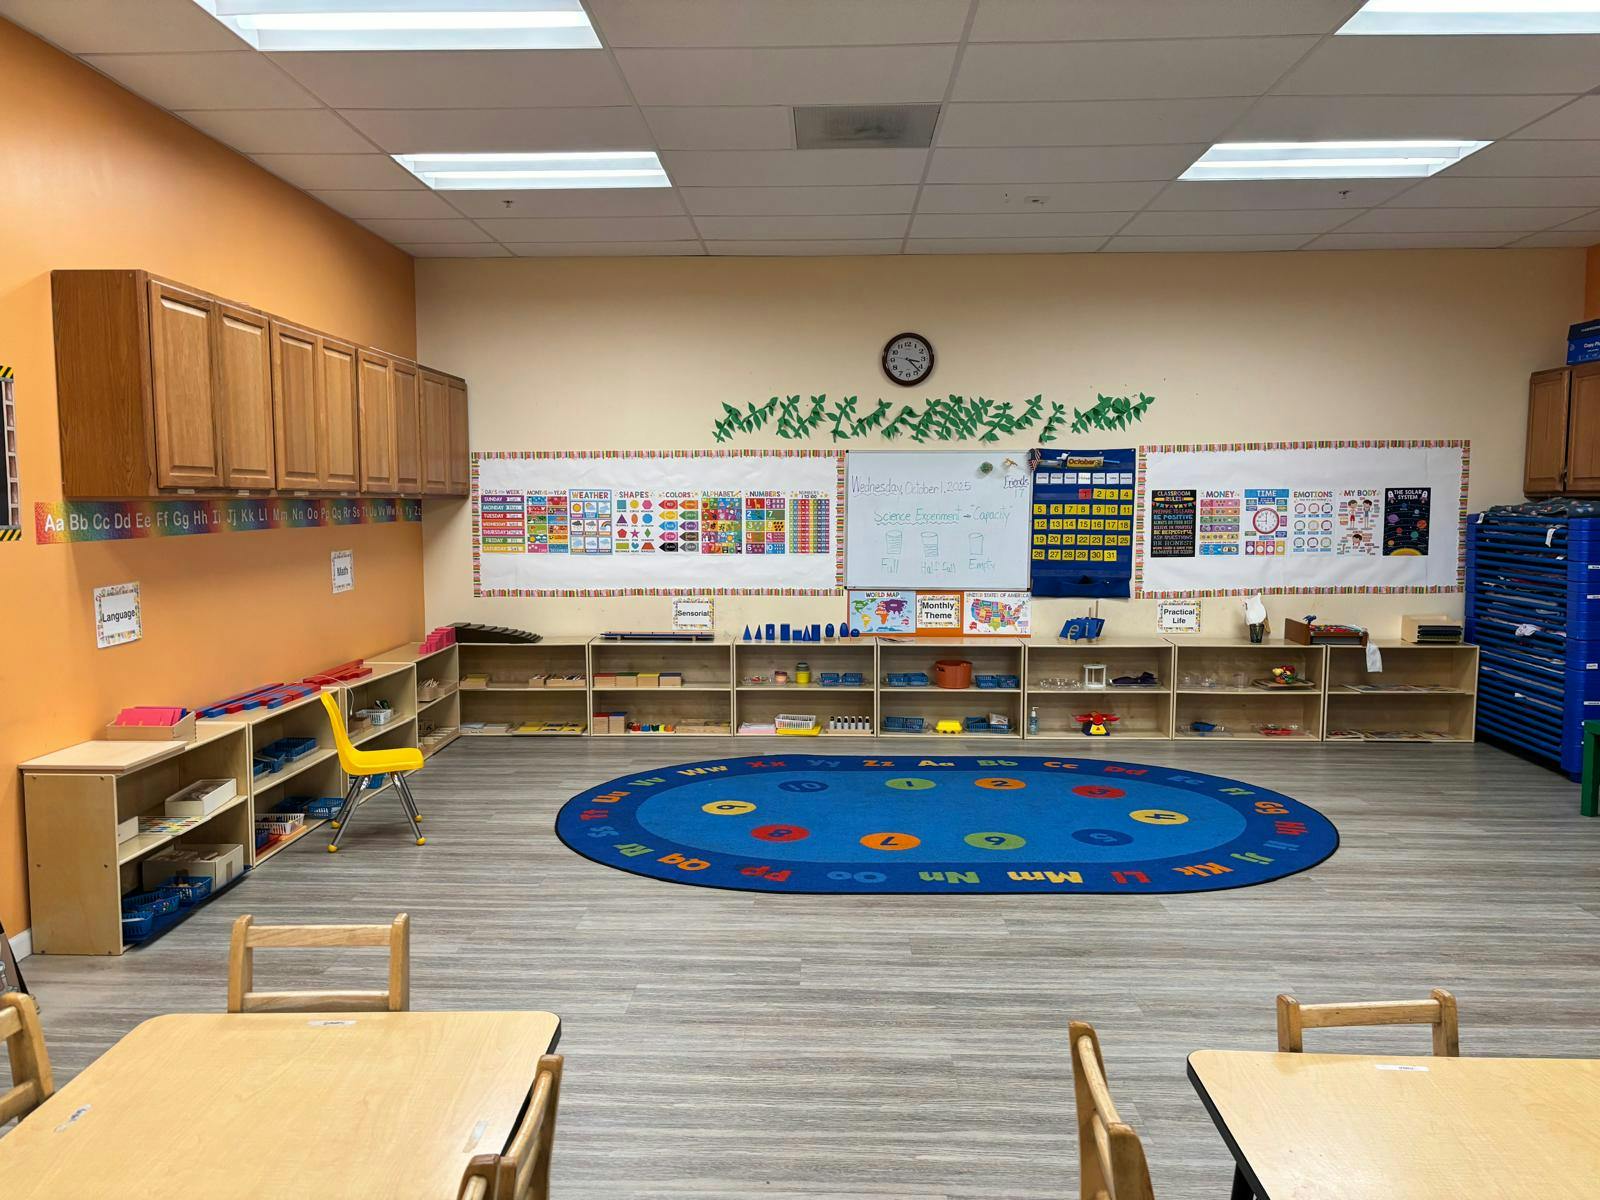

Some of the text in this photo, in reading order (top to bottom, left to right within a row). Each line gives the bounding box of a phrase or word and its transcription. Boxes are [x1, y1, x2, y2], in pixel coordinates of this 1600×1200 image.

[904, 480, 938, 494] October
[947, 481, 972, 492] 2025
[1003, 475, 1029, 488] Friends
[874, 511, 911, 522] Science
[915, 504, 960, 522] Experiment
[44, 514, 65, 533] Aa
[70, 514, 88, 530] Bb
[93, 513, 110, 530] Cc
[114, 512, 131, 529] Dd
[136, 512, 151, 528] Ee
[157, 511, 168, 527] Ff
[173, 511, 189, 529] Gg
[194, 510, 208, 525] Hh
[226, 509, 237, 526] Jj
[241, 508, 255, 522] Kk
[258, 508, 268, 521] Ll
[273, 508, 288, 521] Mm
[292, 508, 304, 520] Nn
[307, 507, 319, 520] Oo
[331, 507, 342, 521] Qq
[343, 507, 351, 518] Rr
[352, 507, 360, 518] Ss
[922, 602, 954, 610] Monthly
[102, 609, 135, 622] Language
[1070, 625, 1079, 635] e
[806, 760, 840, 768] Yy
[1044, 761, 1079, 769] Cc
[677, 766, 728, 777] Ww
[1103, 766, 1148, 776] Dd
[627, 777, 667, 787] Vv
[788, 782, 821, 790] 10
[592, 791, 631, 804] Uu
[1218, 787, 1256, 796] Ff
[1254, 801, 1290, 815] Gg
[587, 826, 619, 838] Ss
[768, 829, 793, 838] 8
[1089, 832, 1118, 844] 5
[880, 836, 898, 846] 7
[984, 836, 1006, 845] 6
[613, 843, 655, 858] Rr
[656, 853, 711, 871] Qq
[739, 865, 794, 882] Pp
[1171, 862, 1234, 877] Kk
[826, 870, 888, 884] Oo
[918, 871, 980, 884] Nn
[1006, 870, 1084, 884] Mm
[1110, 871, 1151, 884] Ll
